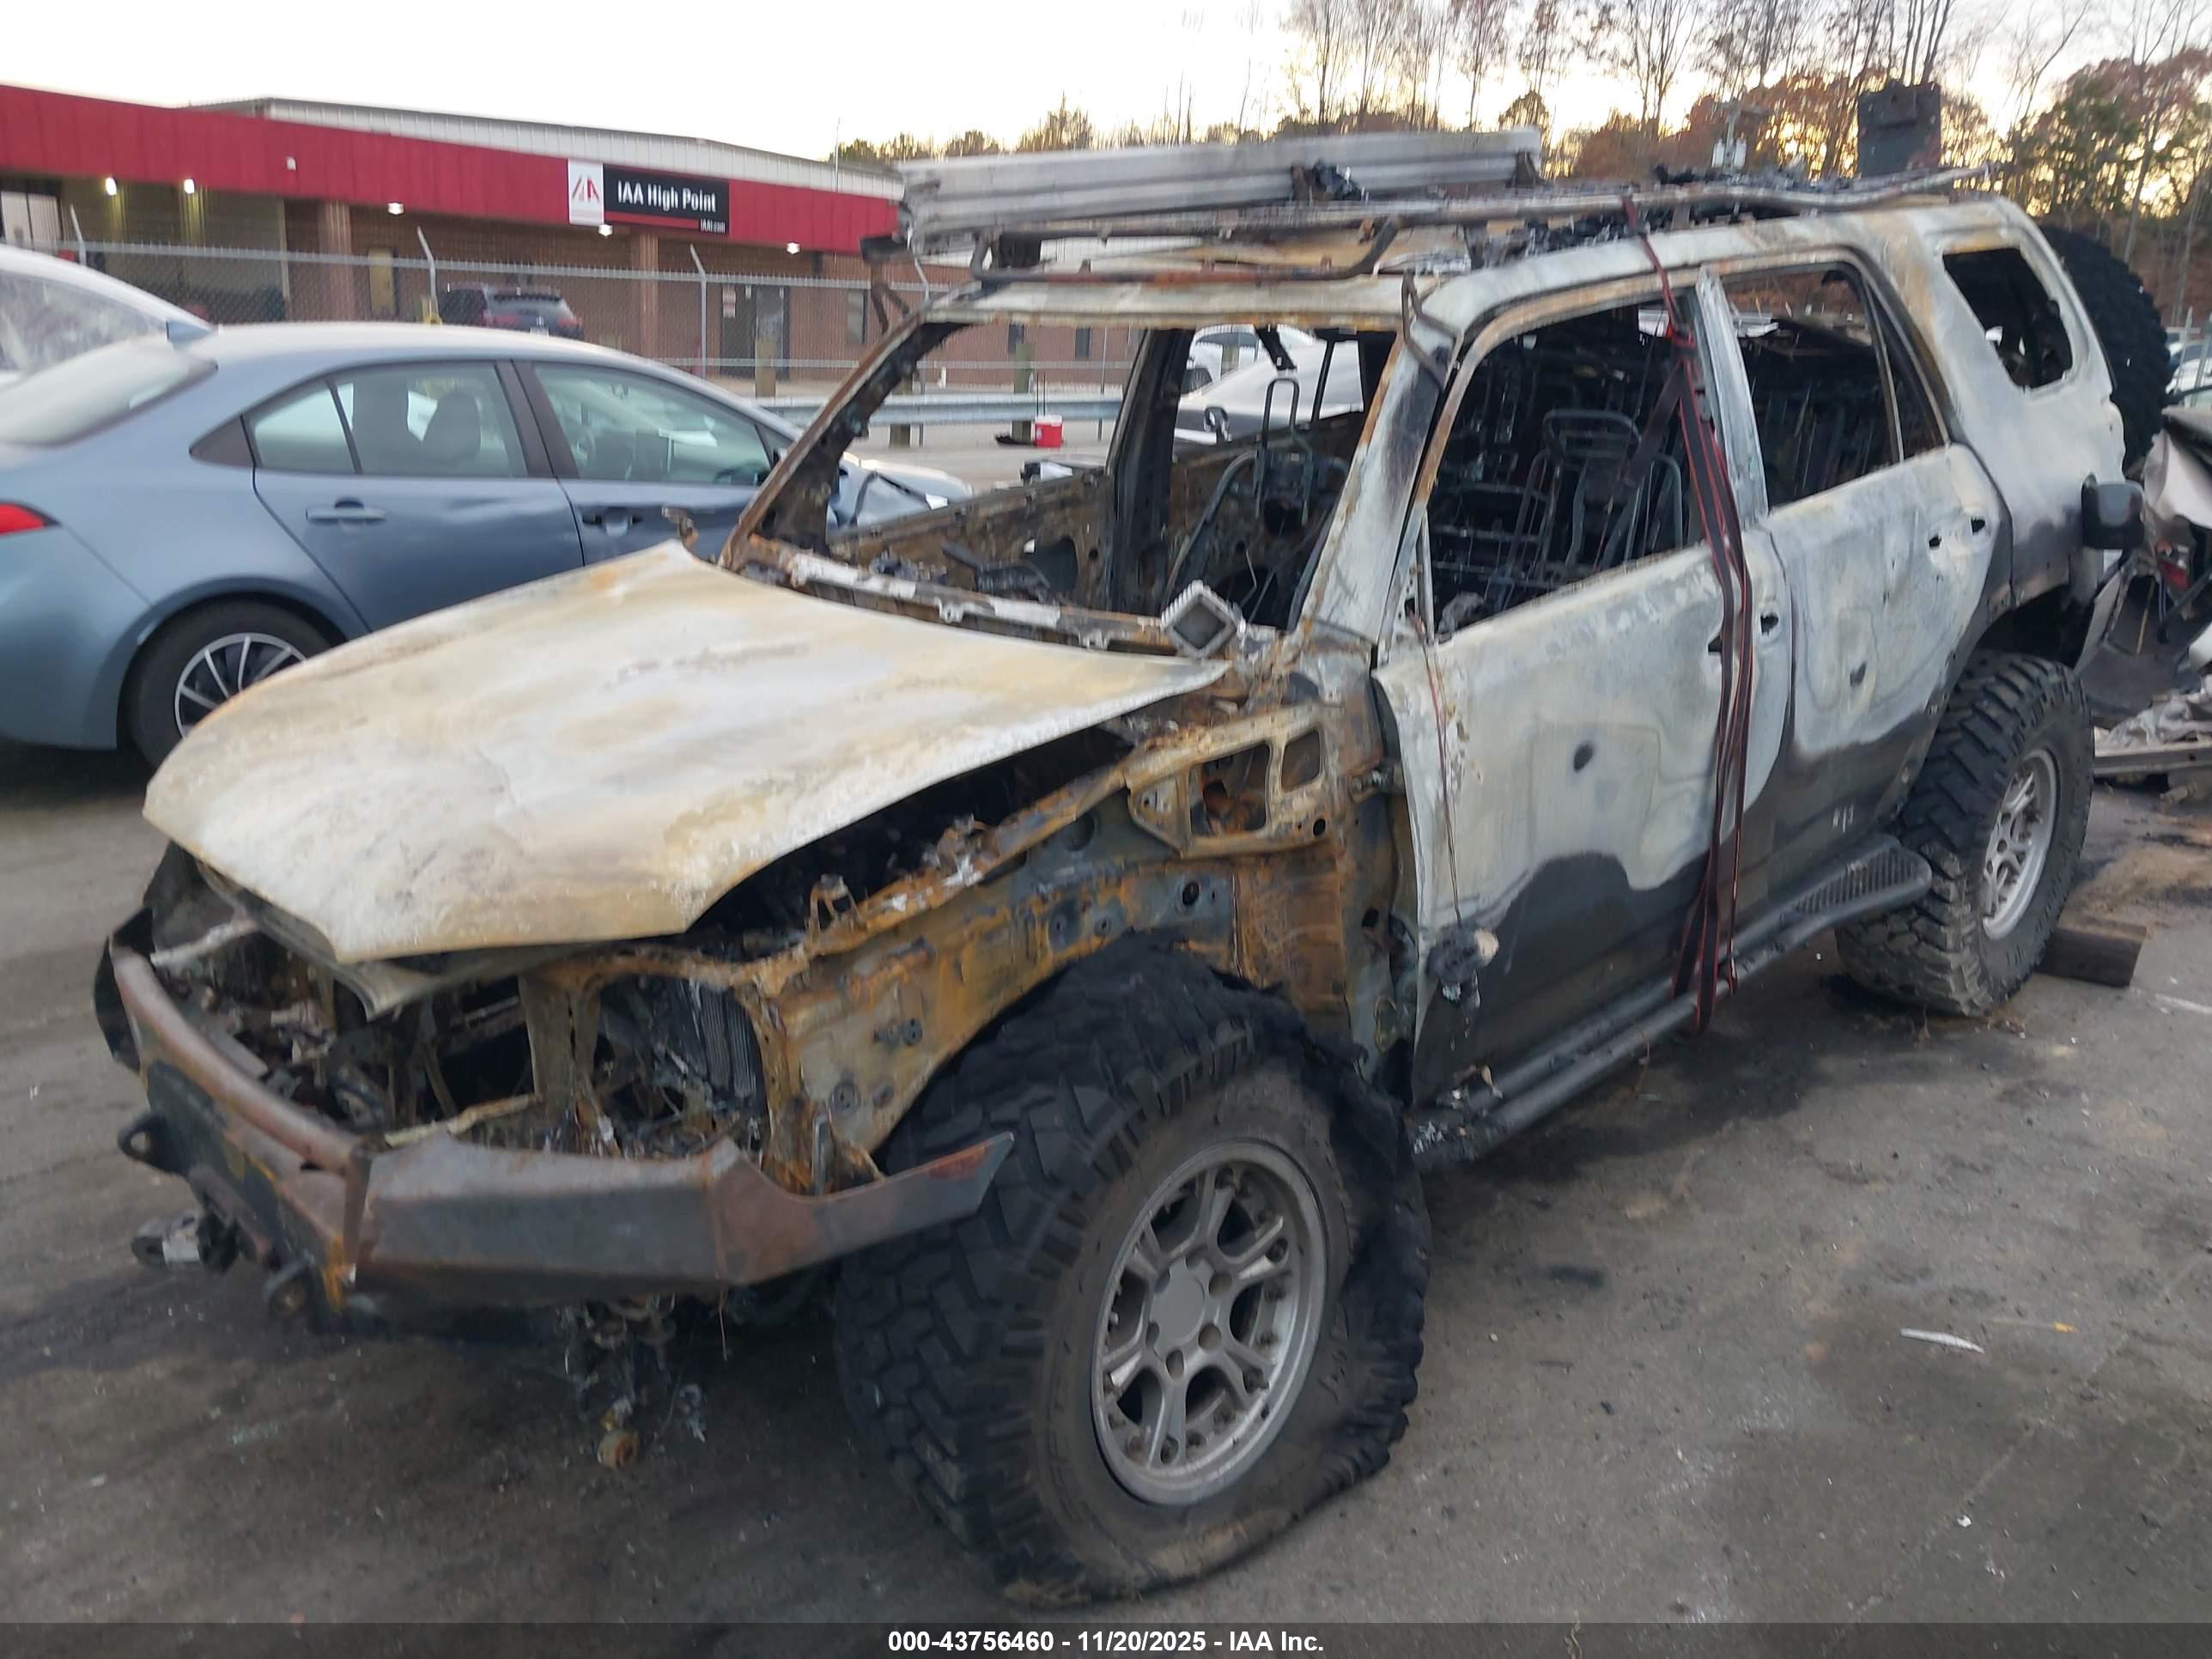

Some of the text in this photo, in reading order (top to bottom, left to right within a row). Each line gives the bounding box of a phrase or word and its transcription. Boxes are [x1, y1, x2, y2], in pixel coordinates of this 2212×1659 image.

[617, 179, 717, 213] IAA High Point
